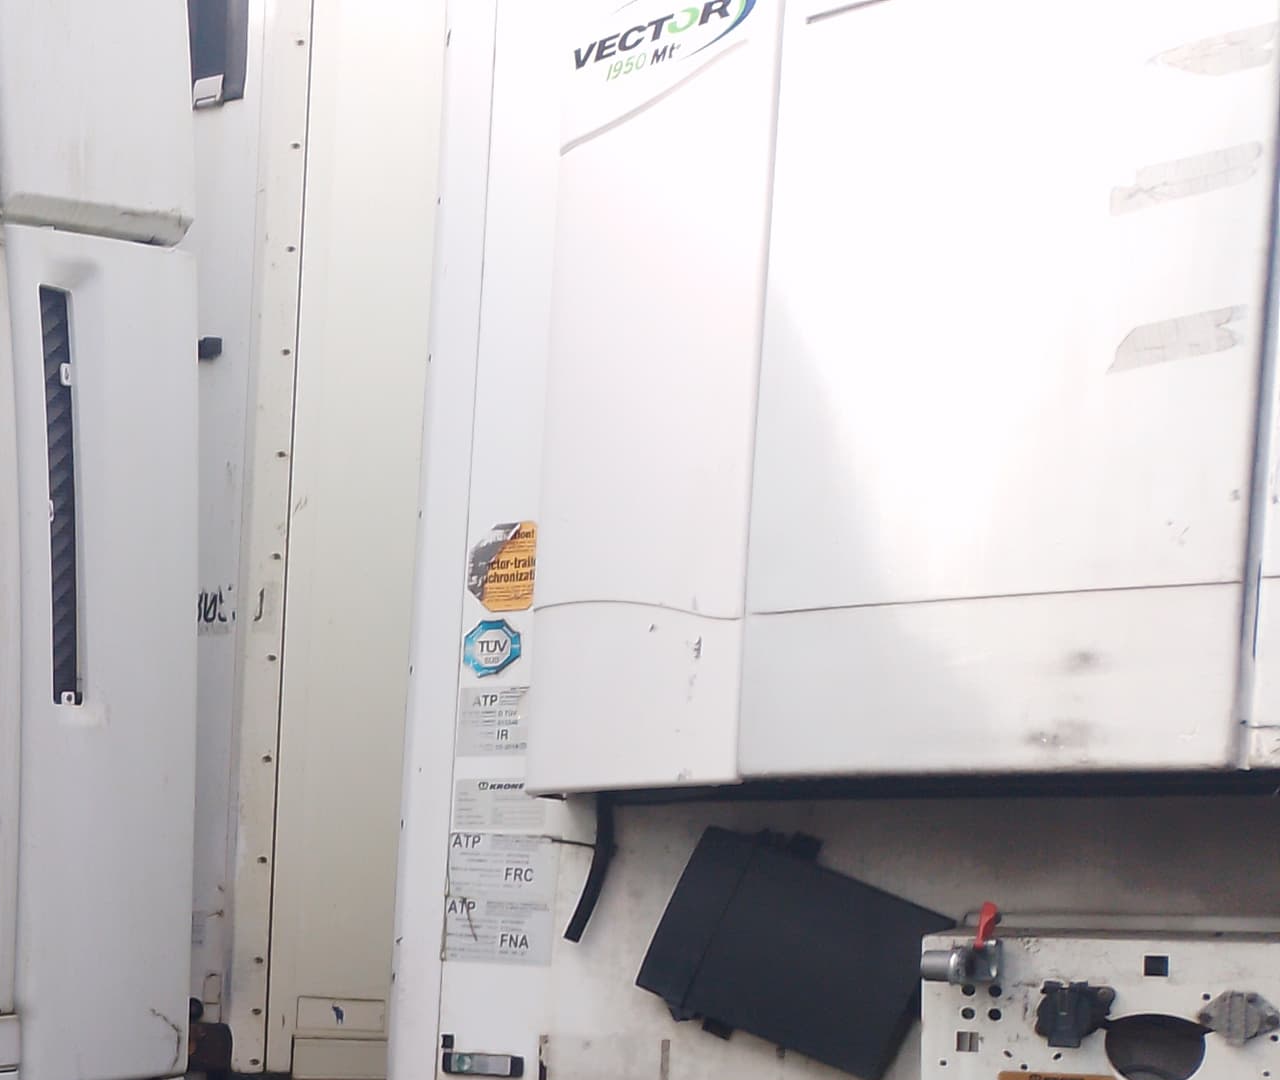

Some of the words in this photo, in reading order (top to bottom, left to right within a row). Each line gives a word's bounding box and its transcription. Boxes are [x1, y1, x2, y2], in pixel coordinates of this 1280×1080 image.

[574, 0, 731, 69] VECTOR
[606, 52, 647, 81] 1950
[473, 694, 498, 706] ATP
[496, 729, 508, 740] IR
[452, 834, 481, 849] ATP
[504, 867, 534, 882] FRC
[448, 900, 476, 915] ATP
[500, 934, 529, 949] FNA
